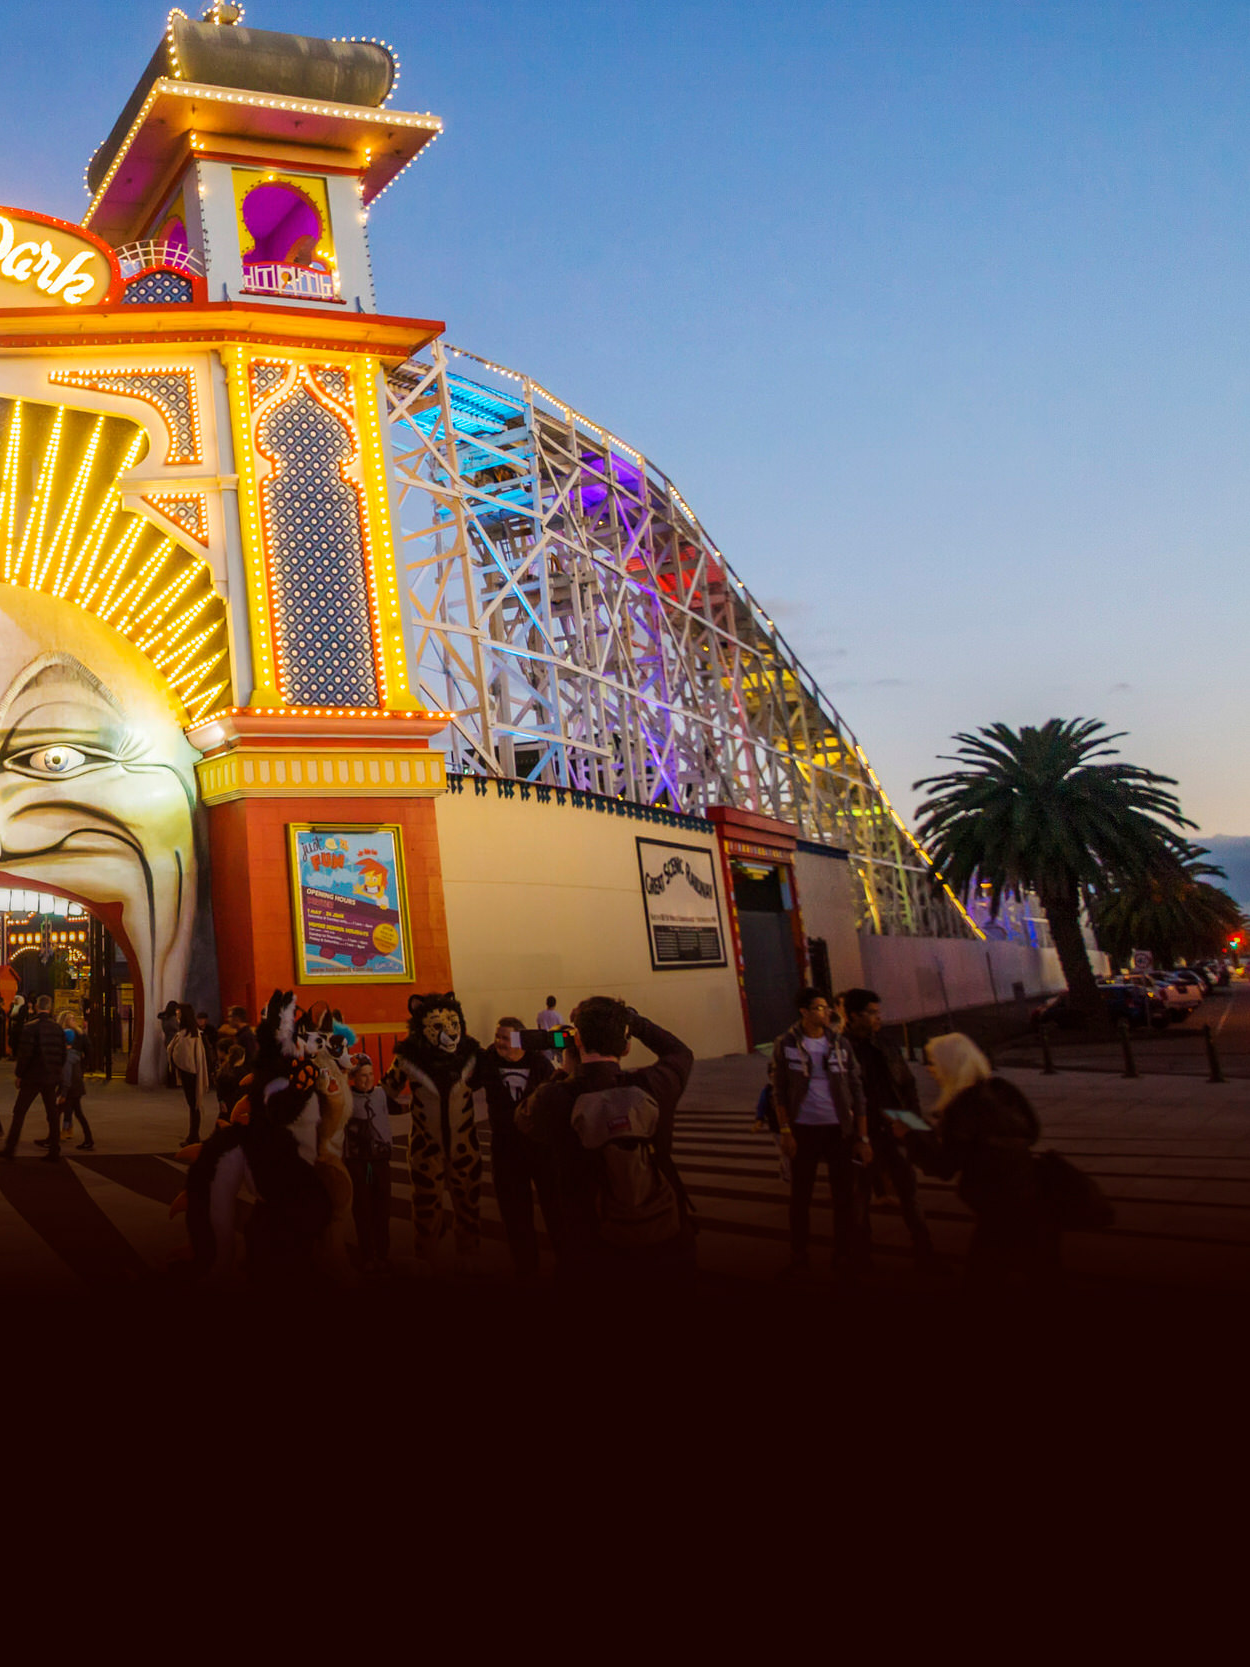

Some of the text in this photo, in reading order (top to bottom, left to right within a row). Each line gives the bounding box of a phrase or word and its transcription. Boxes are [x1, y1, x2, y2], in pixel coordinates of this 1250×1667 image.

[310, 852, 345, 872] FUN
[645, 872, 666, 895] GREAT
[306, 888, 335, 901] OPENING
[334, 895, 356, 906] HOURS
